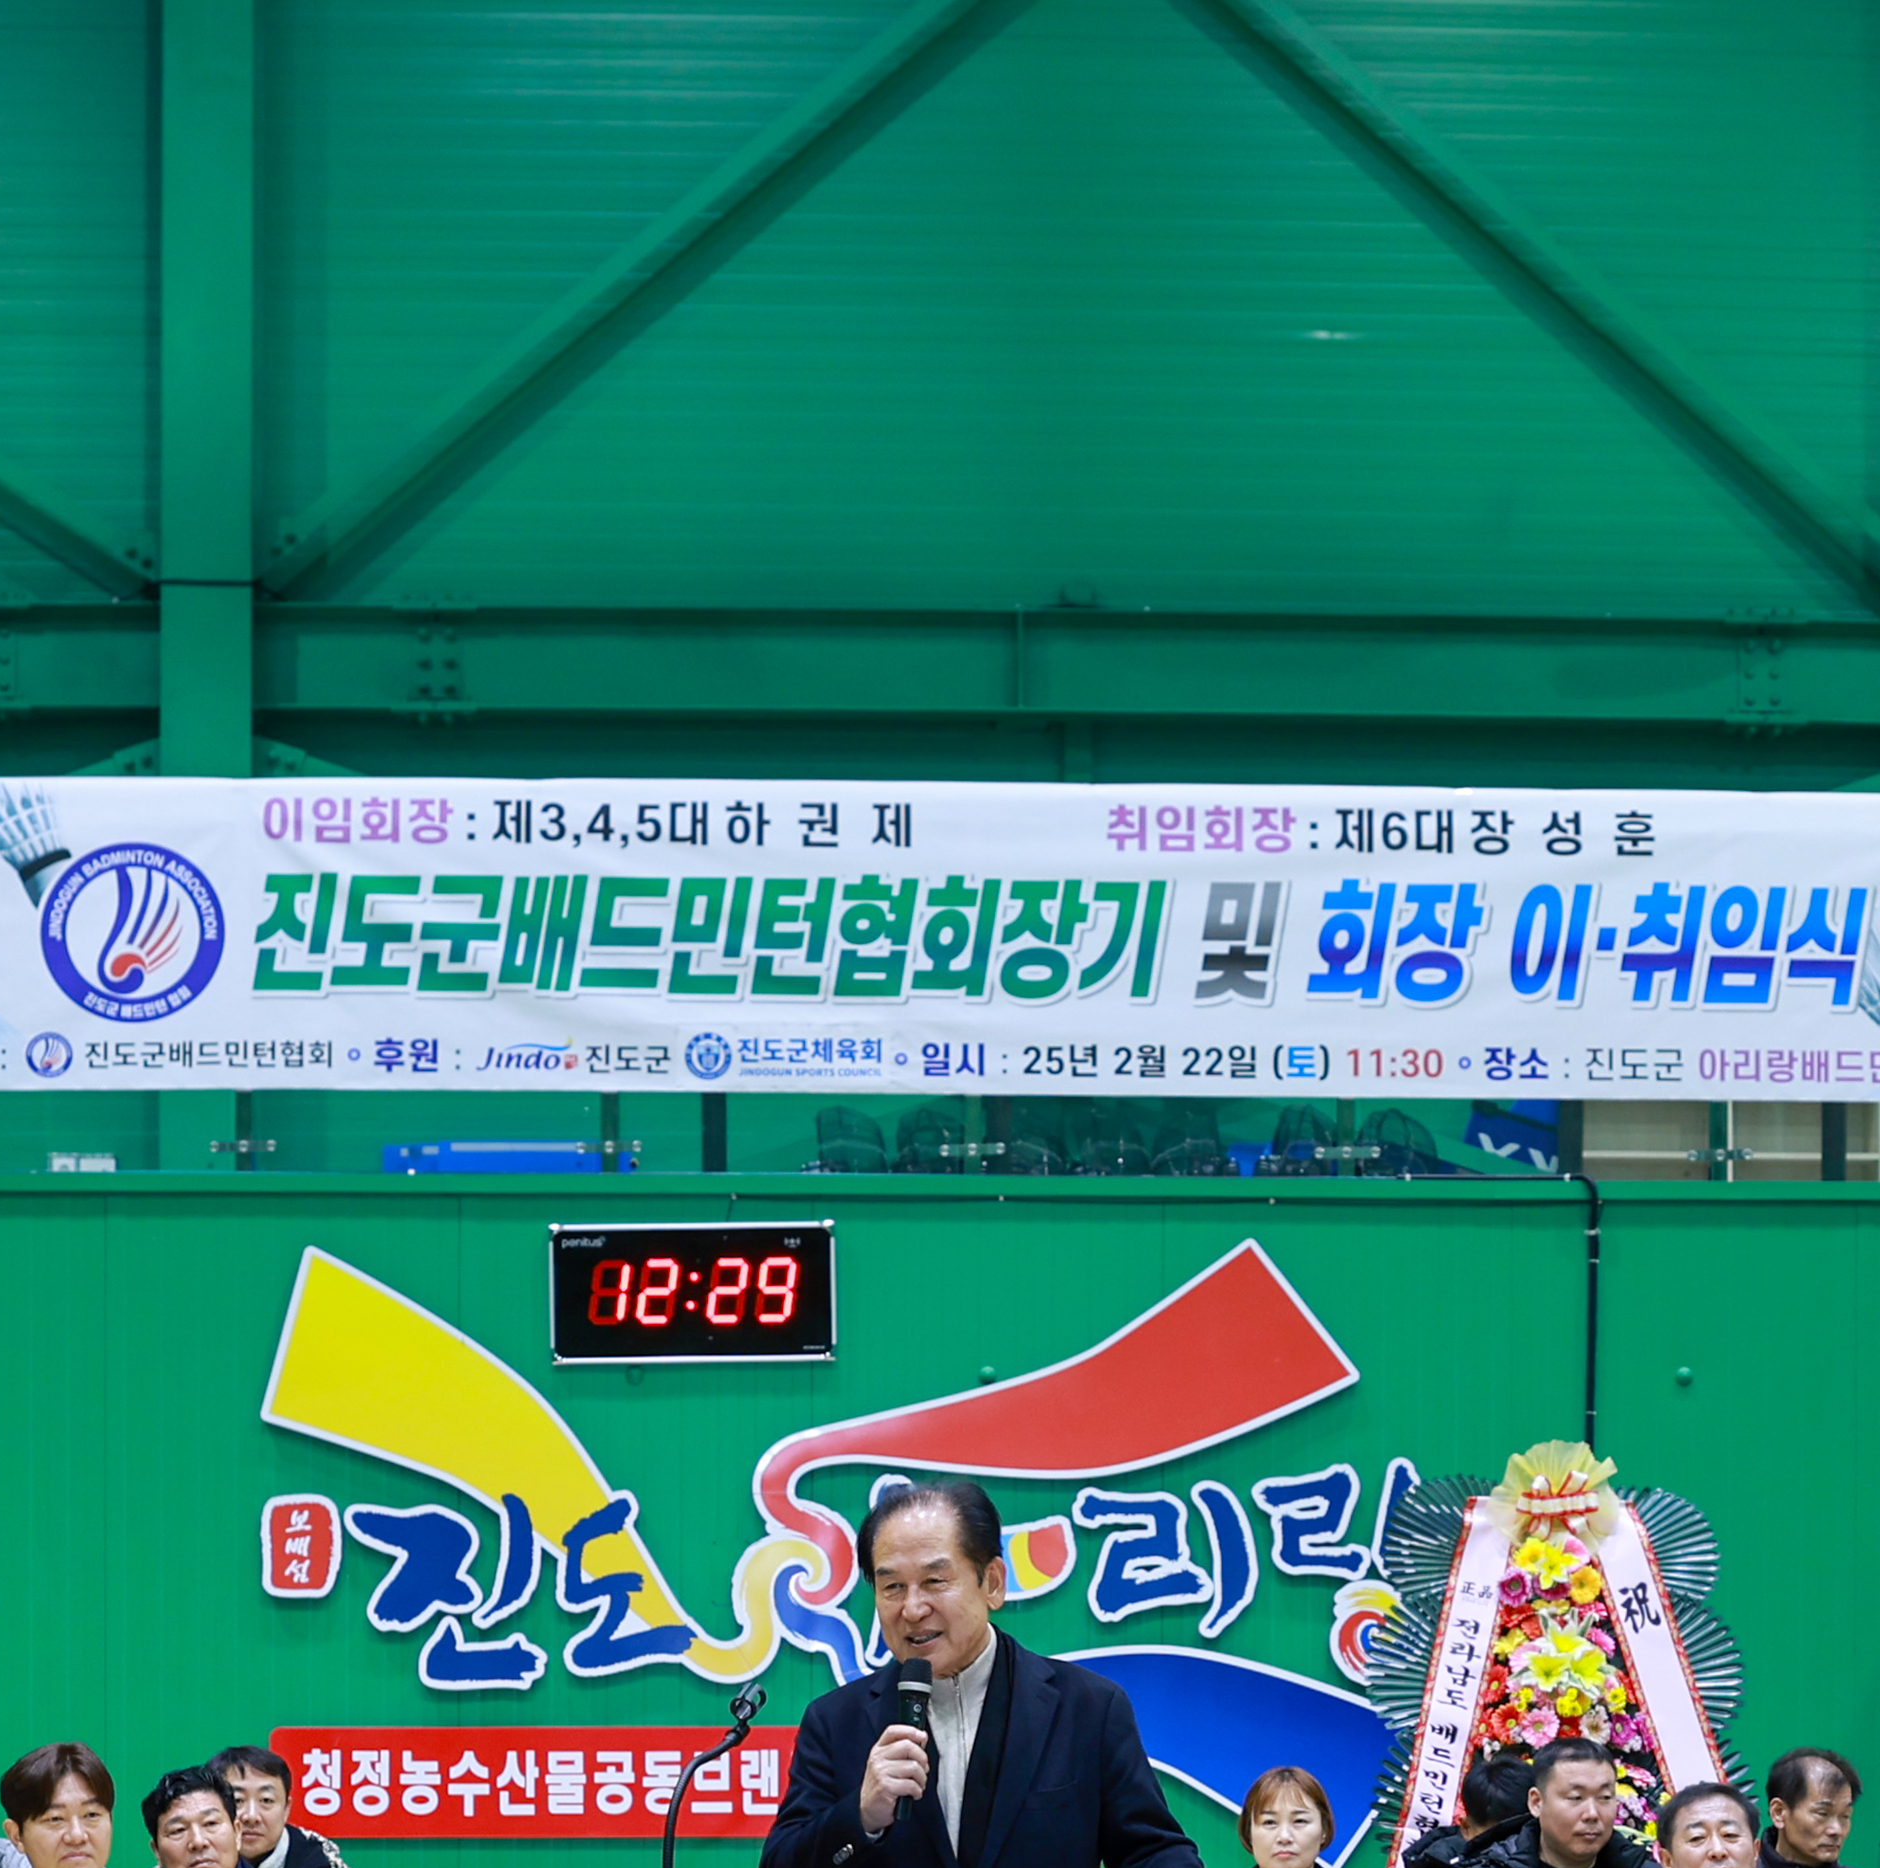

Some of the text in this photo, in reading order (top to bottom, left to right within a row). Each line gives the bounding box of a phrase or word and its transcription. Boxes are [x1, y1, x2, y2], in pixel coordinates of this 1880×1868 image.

[263, 797, 453, 845] 이임회장
[492, 799, 710, 849] 제3,4,5대
[1107, 803, 1297, 854] 취임회장
[1335, 807, 1455, 854] 제6대
[48, 849, 218, 942] JINDOGUN BADMINTON ASSOCIATION
[251, 871, 1869, 1007] 진도군배드민턴협회장기 및 회장 이·취임식
[83, 1039, 334, 1072] 진도군배드민턴협회
[374, 1037, 440, 1073] 후원
[585, 1044, 671, 1075] 진도군
[736, 1037, 883, 1064] 진도군체육회
[738, 1067, 883, 1078] JINDOGUN SPORTS COUNCIL
[920, 1043, 987, 1078] 일시
[1022, 1045, 1099, 1079] 25년
[1113, 1044, 1167, 1079] 2월
[1181, 1045, 1257, 1079] 22일
[1272, 1043, 1331, 1081] (토)
[1346, 1048, 1444, 1079] 11:30
[1483, 1046, 1550, 1082] 장소
[1585, 1047, 1684, 1082] 진도군
[614, 1256, 799, 1326] 12:29
[344, 1489, 699, 1686] 진도
[1619, 1581, 1662, 1634] 祝
[1436, 1617, 1482, 1711] 전라남도
[1408, 1722, 1459, 1844] 배드민턴협
